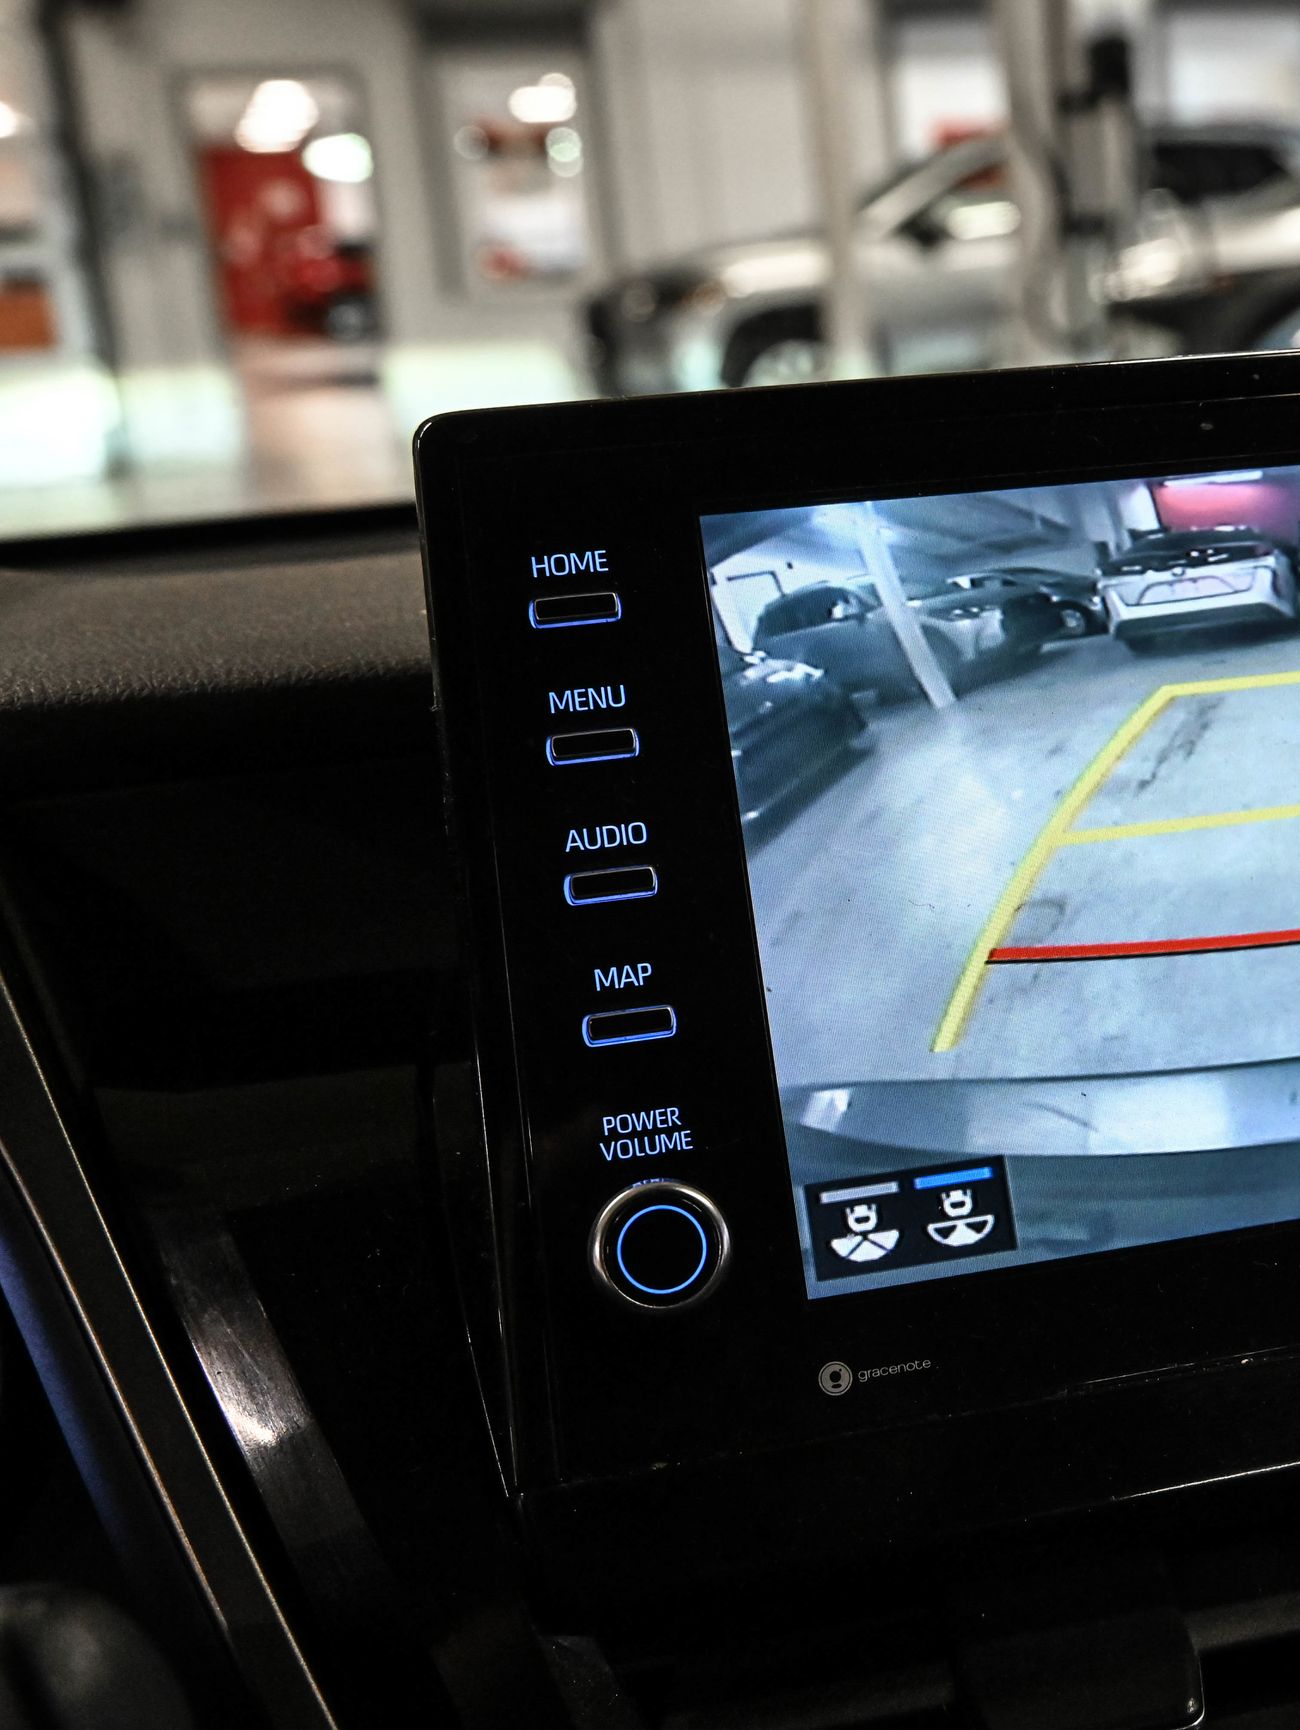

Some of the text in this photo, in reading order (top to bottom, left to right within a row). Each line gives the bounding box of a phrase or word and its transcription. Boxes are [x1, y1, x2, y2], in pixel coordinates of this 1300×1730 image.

[530, 550, 609, 578] HOME
[548, 684, 626, 714] MENU
[565, 821, 648, 852] AUDIO
[593, 962, 652, 991] MAP
[602, 1106, 682, 1136] POWER
[600, 1130, 694, 1161] VOLUME
[857, 1359, 932, 1383] gracenote
